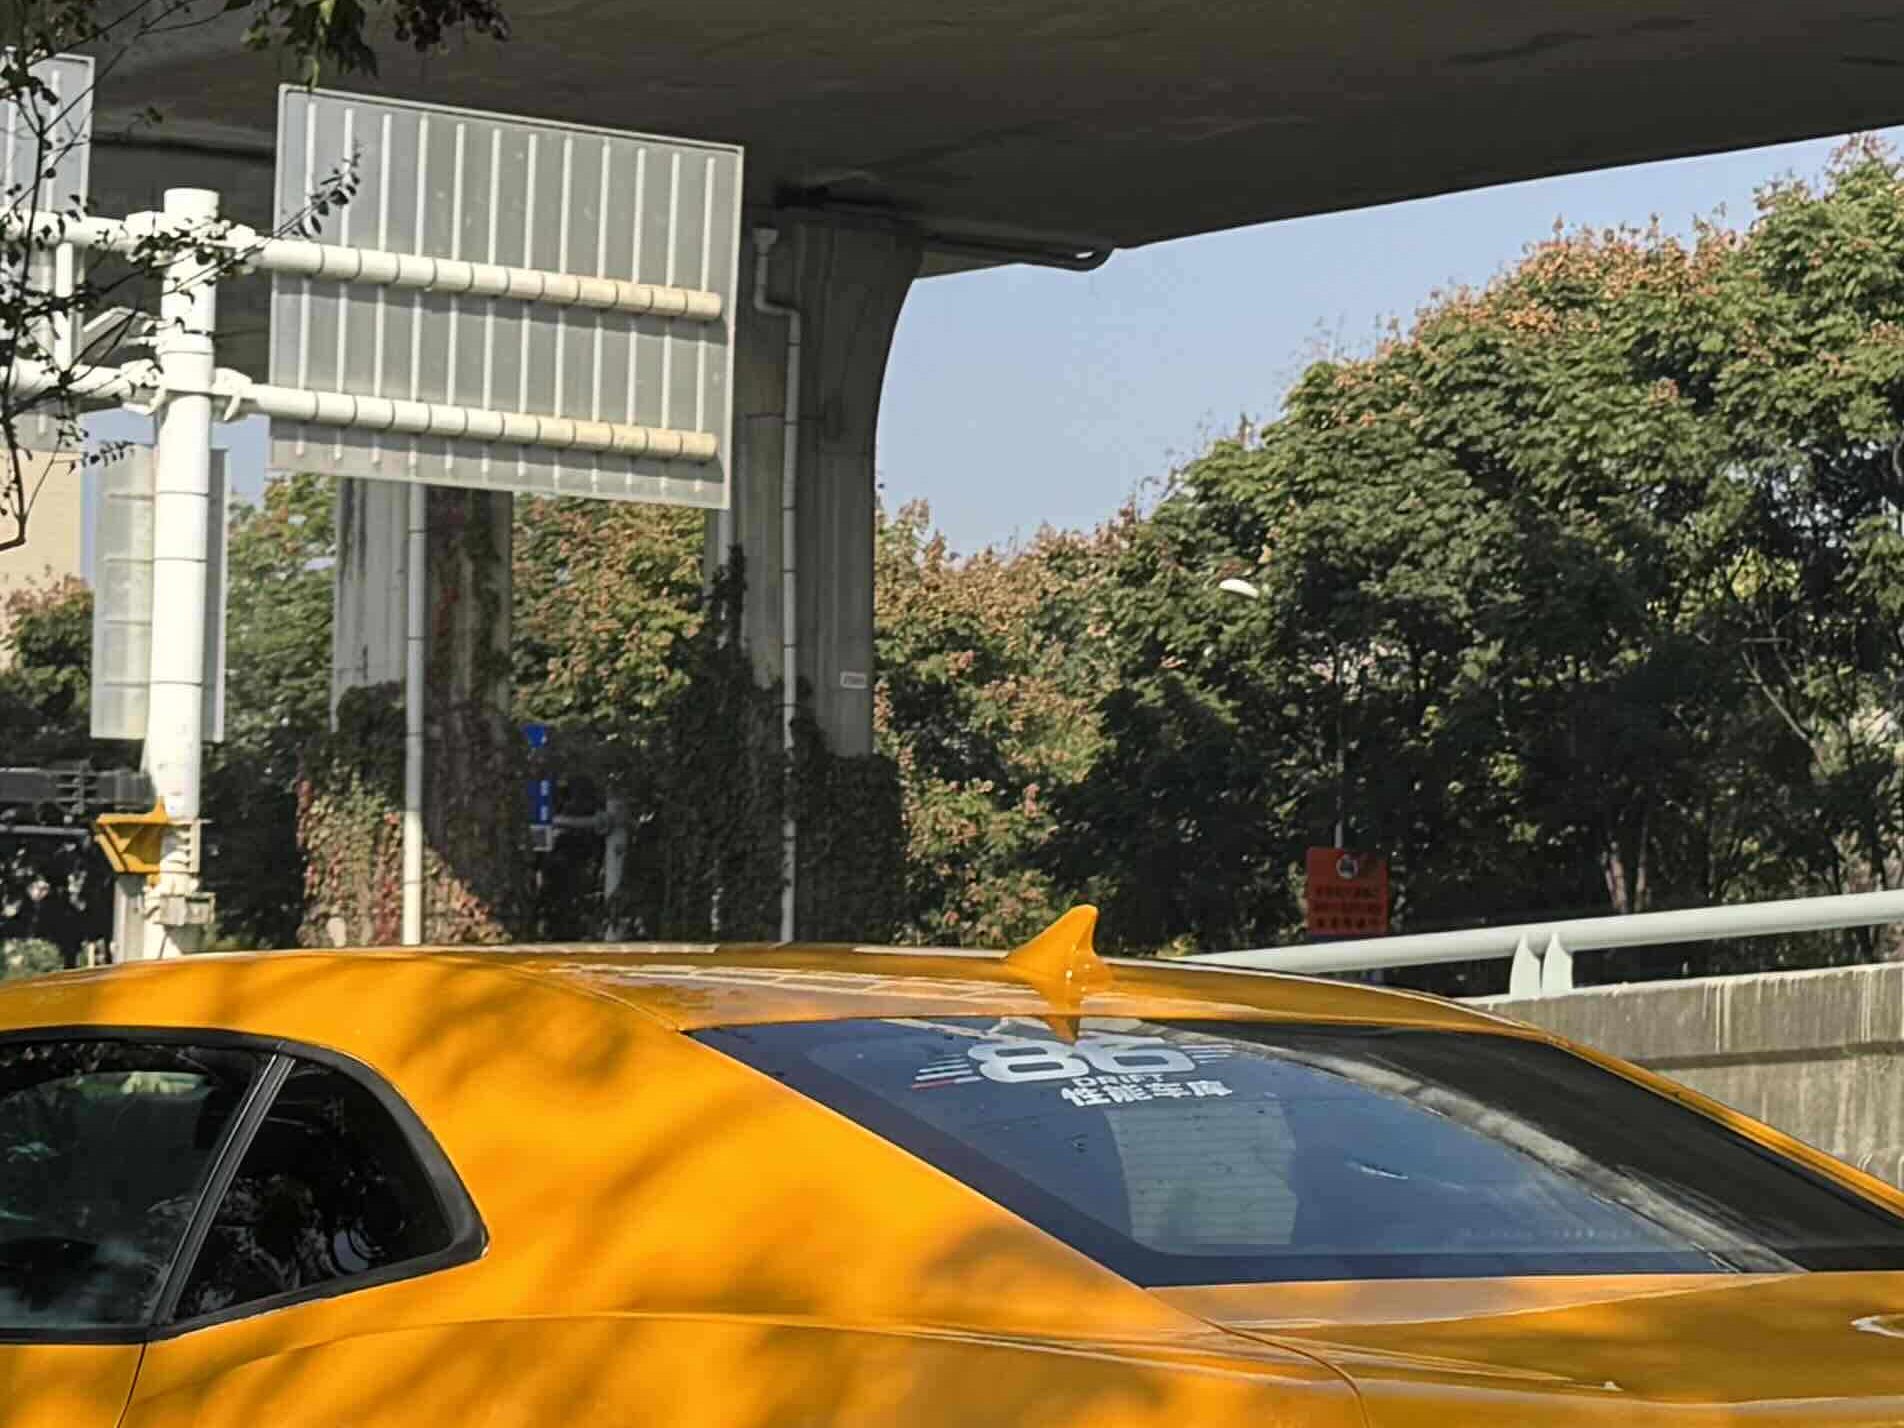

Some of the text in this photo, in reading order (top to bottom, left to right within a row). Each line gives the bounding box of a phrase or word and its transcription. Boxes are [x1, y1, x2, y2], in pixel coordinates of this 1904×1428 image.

[968, 1035, 1195, 1082] 86
[1061, 1080, 1233, 1107] 性能车库
[1072, 1073, 1164, 1087] DRIFT
